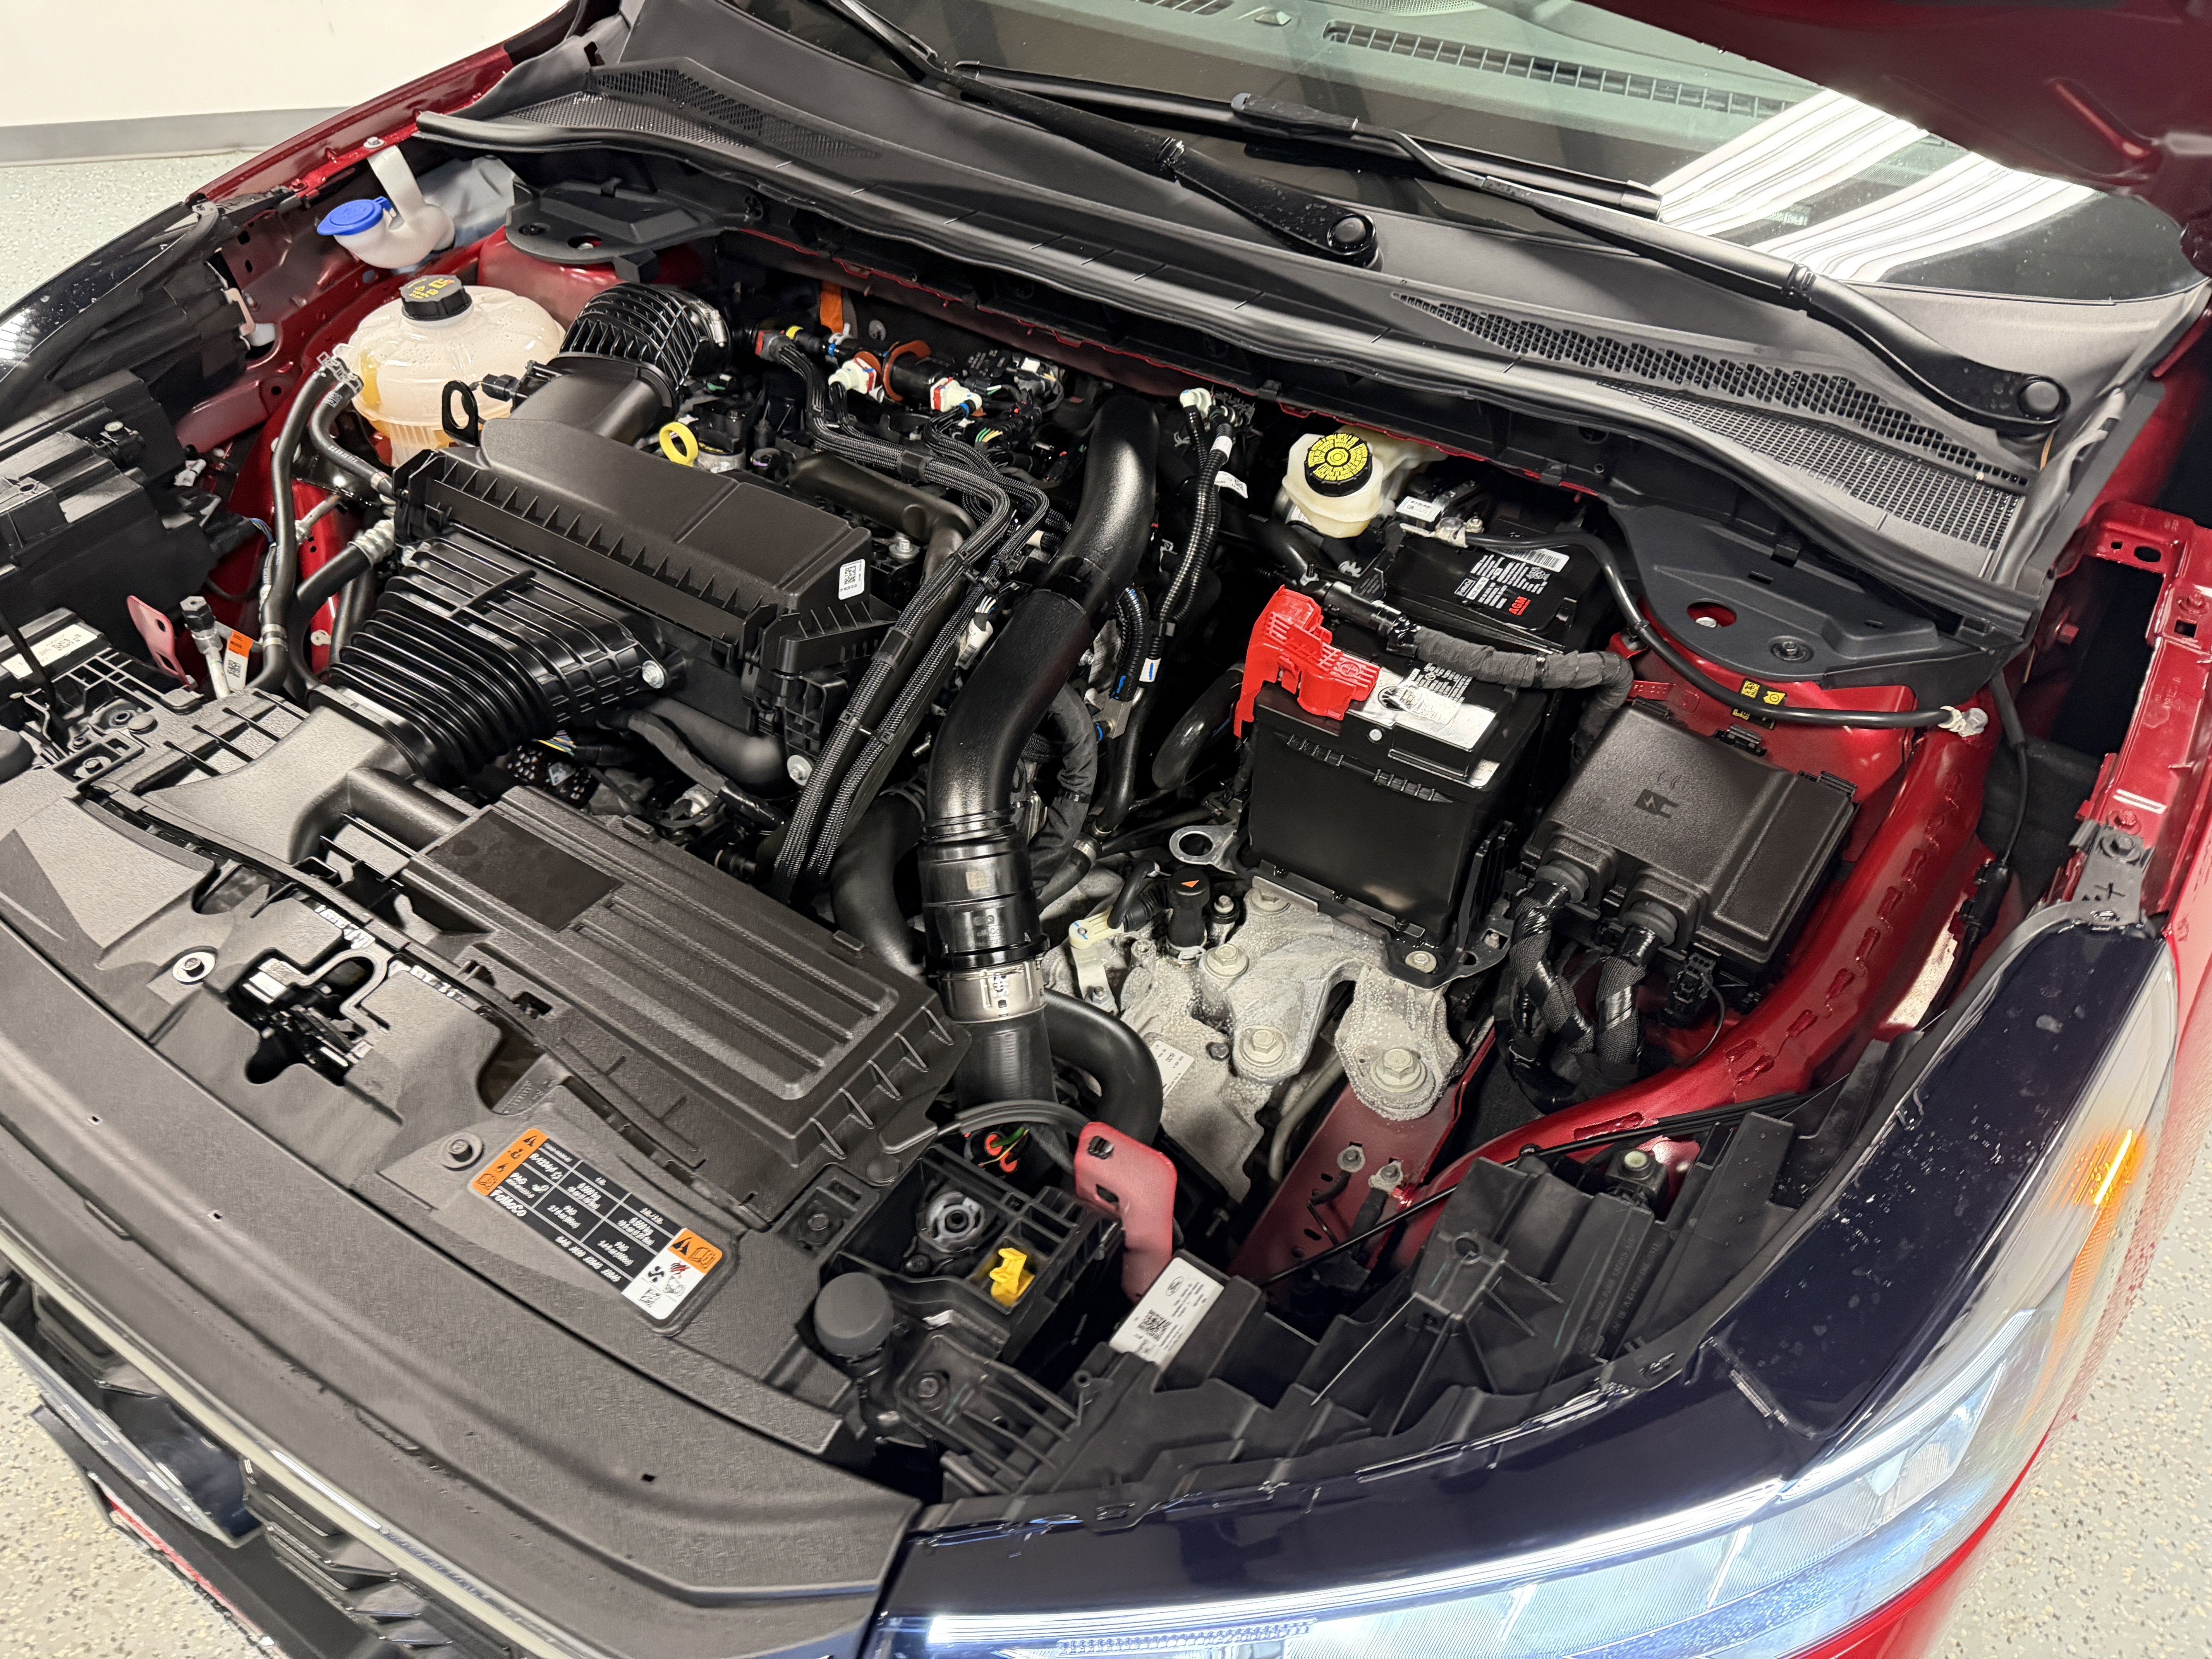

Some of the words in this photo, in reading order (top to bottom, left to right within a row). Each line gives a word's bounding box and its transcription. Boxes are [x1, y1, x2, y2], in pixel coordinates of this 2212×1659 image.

[1509, 596, 1528, 615] AGM
[510, 1172, 527, 1184] PAG
[490, 1189, 526, 1216] FoMoCo
